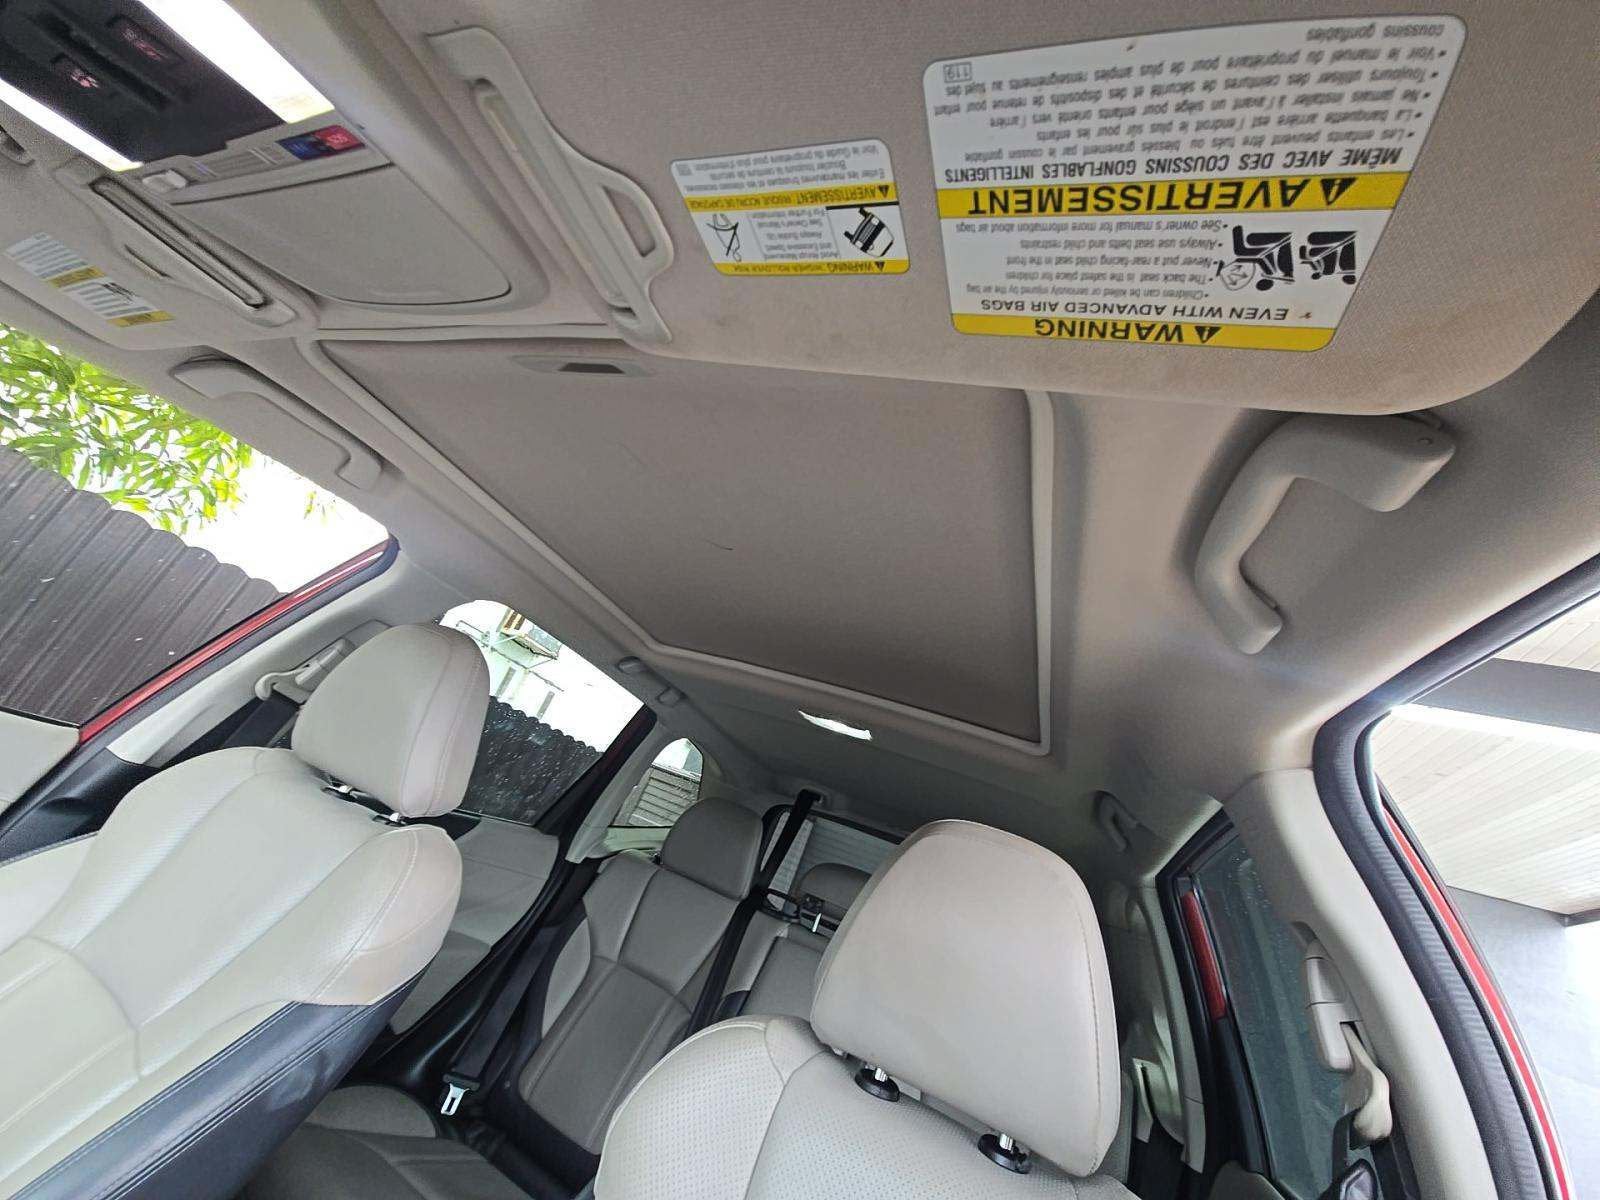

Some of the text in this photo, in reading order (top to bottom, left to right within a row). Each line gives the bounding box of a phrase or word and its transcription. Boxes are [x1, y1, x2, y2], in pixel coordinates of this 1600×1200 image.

[1305, 23, 1445, 44] coussins gonflables
[1305, 50, 1325, 65] du
[1387, 49, 1401, 62] le
[1407, 47, 1436, 62] Voir
[1139, 61, 1165, 78] plus
[1169, 61, 1185, 76] de
[1191, 55, 1220, 72] pour
[947, 66, 969, 80] 119
[1287, 73, 1311, 87] des
[1369, 68, 1427, 84] Toujours
[945, 85, 962, 98] des
[1108, 87, 1128, 101] des
[1202, 80, 1218, 94] de
[1032, 96, 1045, 108] de
[1402, 89, 1422, 102] Ne
[934, 104, 961, 117] enfant
[966, 101, 988, 113] pour
[1141, 102, 1169, 116] pour
[1210, 99, 1227, 111] un
[1032, 113, 1052, 125] vers
[1098, 106, 1137, 120] enfants
[1395, 109, 1414, 122] La
[1150, 121, 1173, 135] plus
[1178, 122, 1189, 133] le
[1251, 116, 1271, 128] est
[1036, 129, 1071, 142] enfants
[1076, 128, 1091, 140] les
[1097, 124, 1121, 138] pour
[1270, 130, 1322, 146] peuvent
[1326, 129, 1375, 143] enfants
[1381, 129, 1406, 141] Les
[1048, 148, 1057, 159] le
[1061, 145, 1078, 157] par
[1082, 141, 1135, 157] gravement
[944, 148, 1403, 183] MÊME AVEC DES COUSSINS GONFLABLES INTELLIGENTS
[796, 185, 876, 205] AVERTISSEMENT
[967, 178, 1311, 215] AVERTISSEMENT
[955, 220, 1222, 234] See owner's manual for more information about air bags
[1020, 237, 1218, 249] Always use seat belts and child restraints
[1006, 255, 1212, 268] Never put a rear-facing child seat in the front
[1006, 271, 1207, 285] The back seat is the safest place for children
[966, 283, 1204, 299] Children can be killed or seriously injured by the air bag
[980, 299, 1289, 321] EVEN WITH ADVANCED AIR BAGS
[1034, 319, 1184, 343] WARNING
